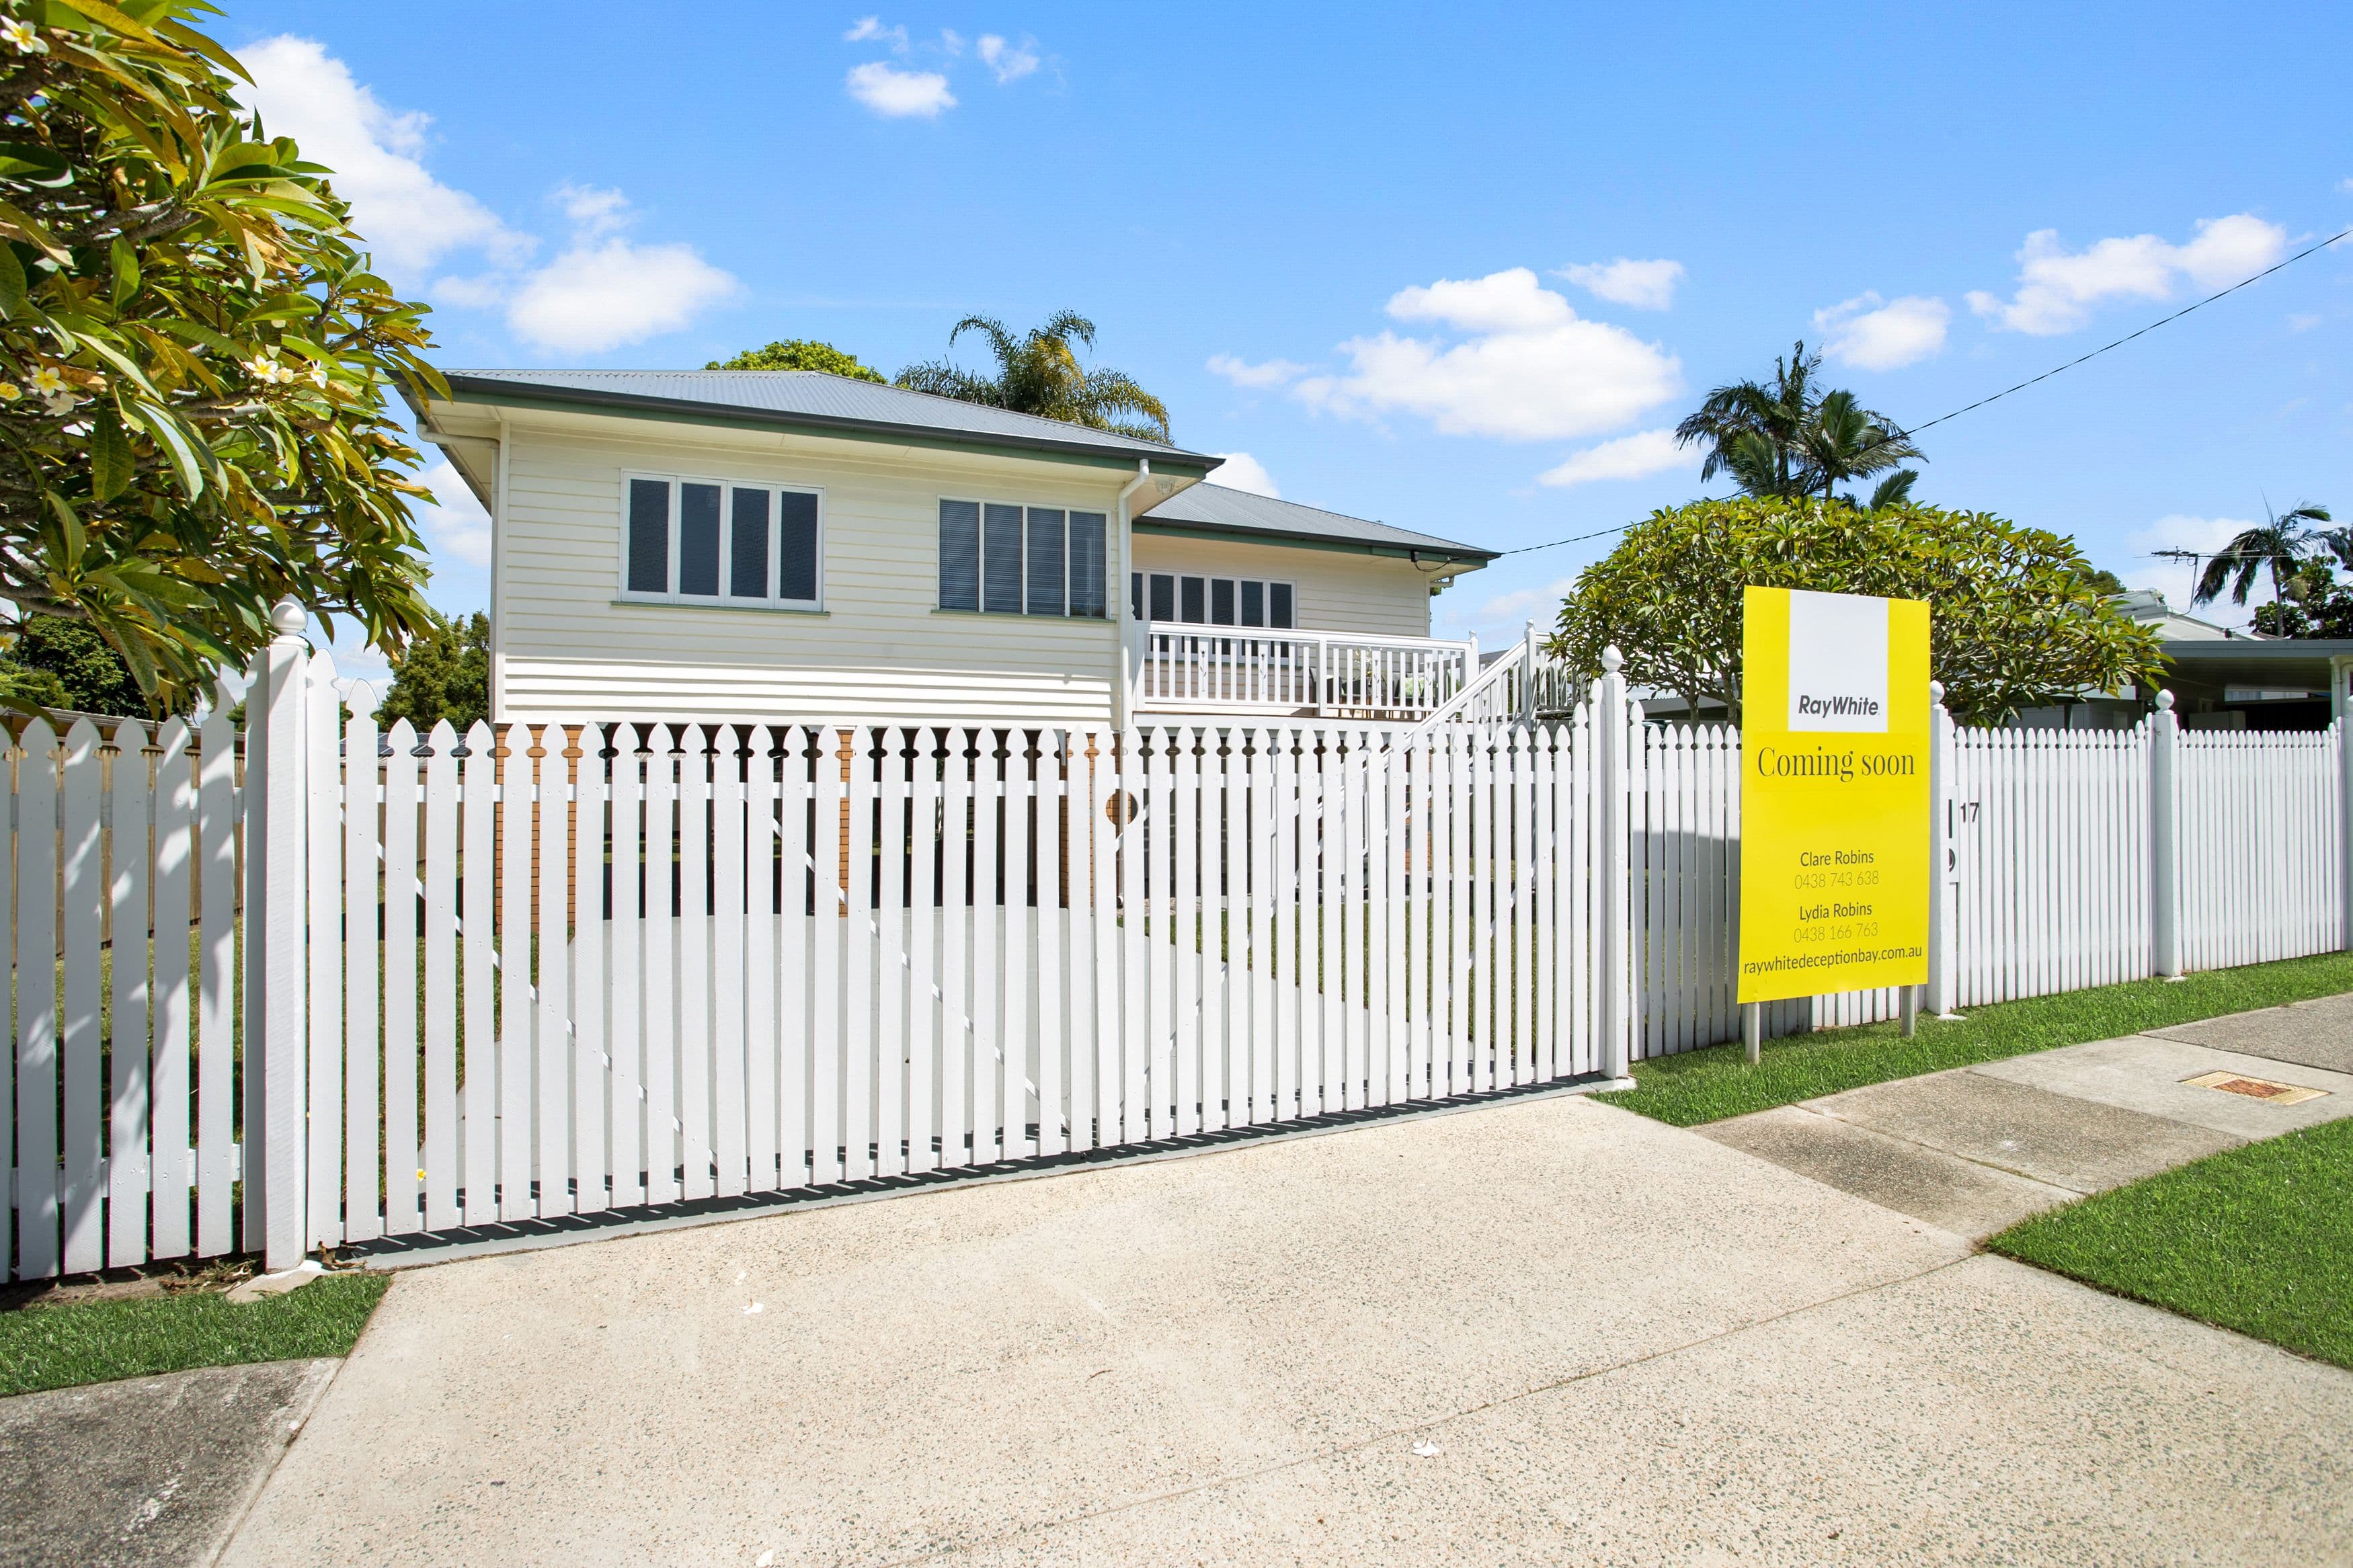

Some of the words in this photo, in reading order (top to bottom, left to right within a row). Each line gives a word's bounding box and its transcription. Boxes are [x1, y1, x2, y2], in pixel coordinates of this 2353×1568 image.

[1758, 746, 1853, 782] Coming
[1862, 753, 1915, 776] soon
[1960, 802, 1979, 823] 17
[1800, 852, 1831, 866] Clare
[1835, 850, 1874, 865] Robins
[1794, 874, 1826, 889] 0438
[1831, 872, 1852, 886] 743
[1857, 870, 1879, 885] 638
[1800, 905, 1829, 923] Lydia
[1833, 902, 1872, 917] Robins
[1794, 927, 1825, 943] 0438
[1830, 924, 1851, 940] 166
[1856, 922, 1878, 938] 763
[1744, 946, 1922, 976] raywhitedeceptionbay.com.au
